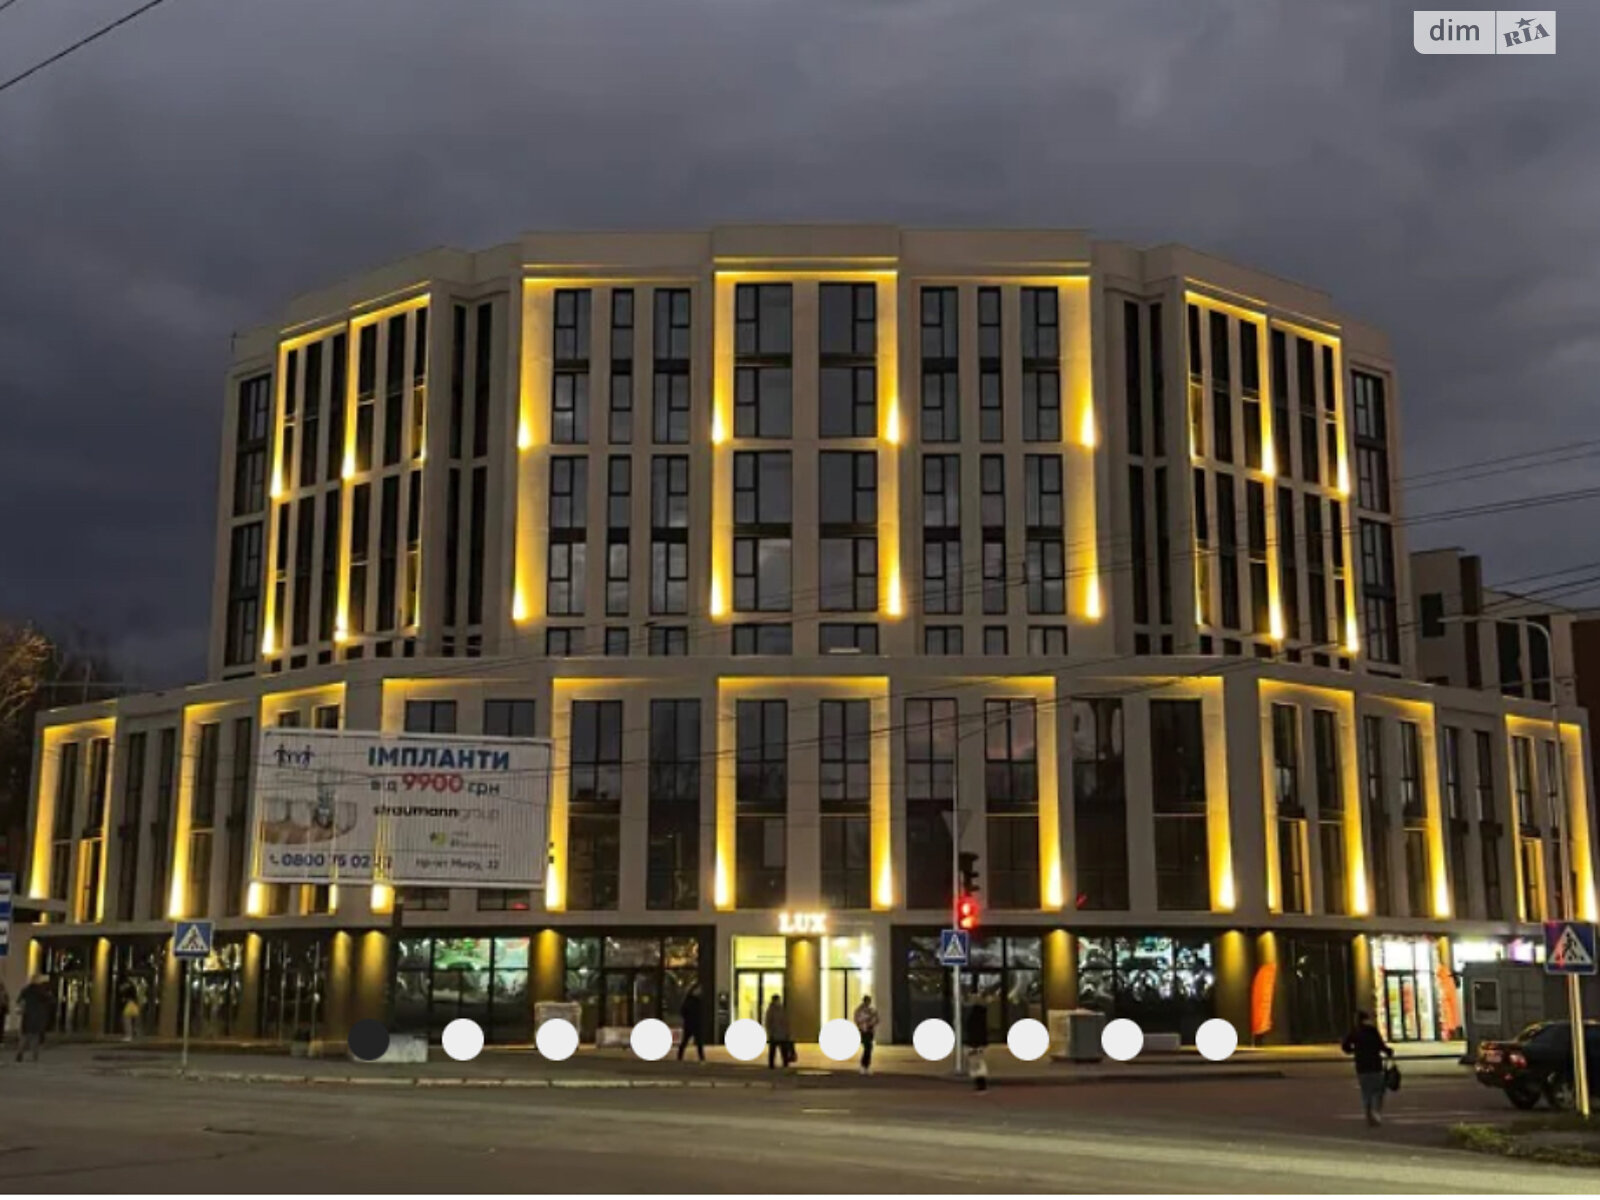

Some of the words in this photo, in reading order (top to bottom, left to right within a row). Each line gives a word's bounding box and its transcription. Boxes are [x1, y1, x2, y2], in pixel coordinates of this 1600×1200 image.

[368, 746, 509, 770] ІМПЛАНТИ
[370, 780, 398, 792] вд
[402, 773, 464, 793] 9900
[467, 782, 500, 796] грн
[282, 853, 324, 867] 0800
[351, 854, 370, 868] 02
[778, 912, 826, 933] LUX
